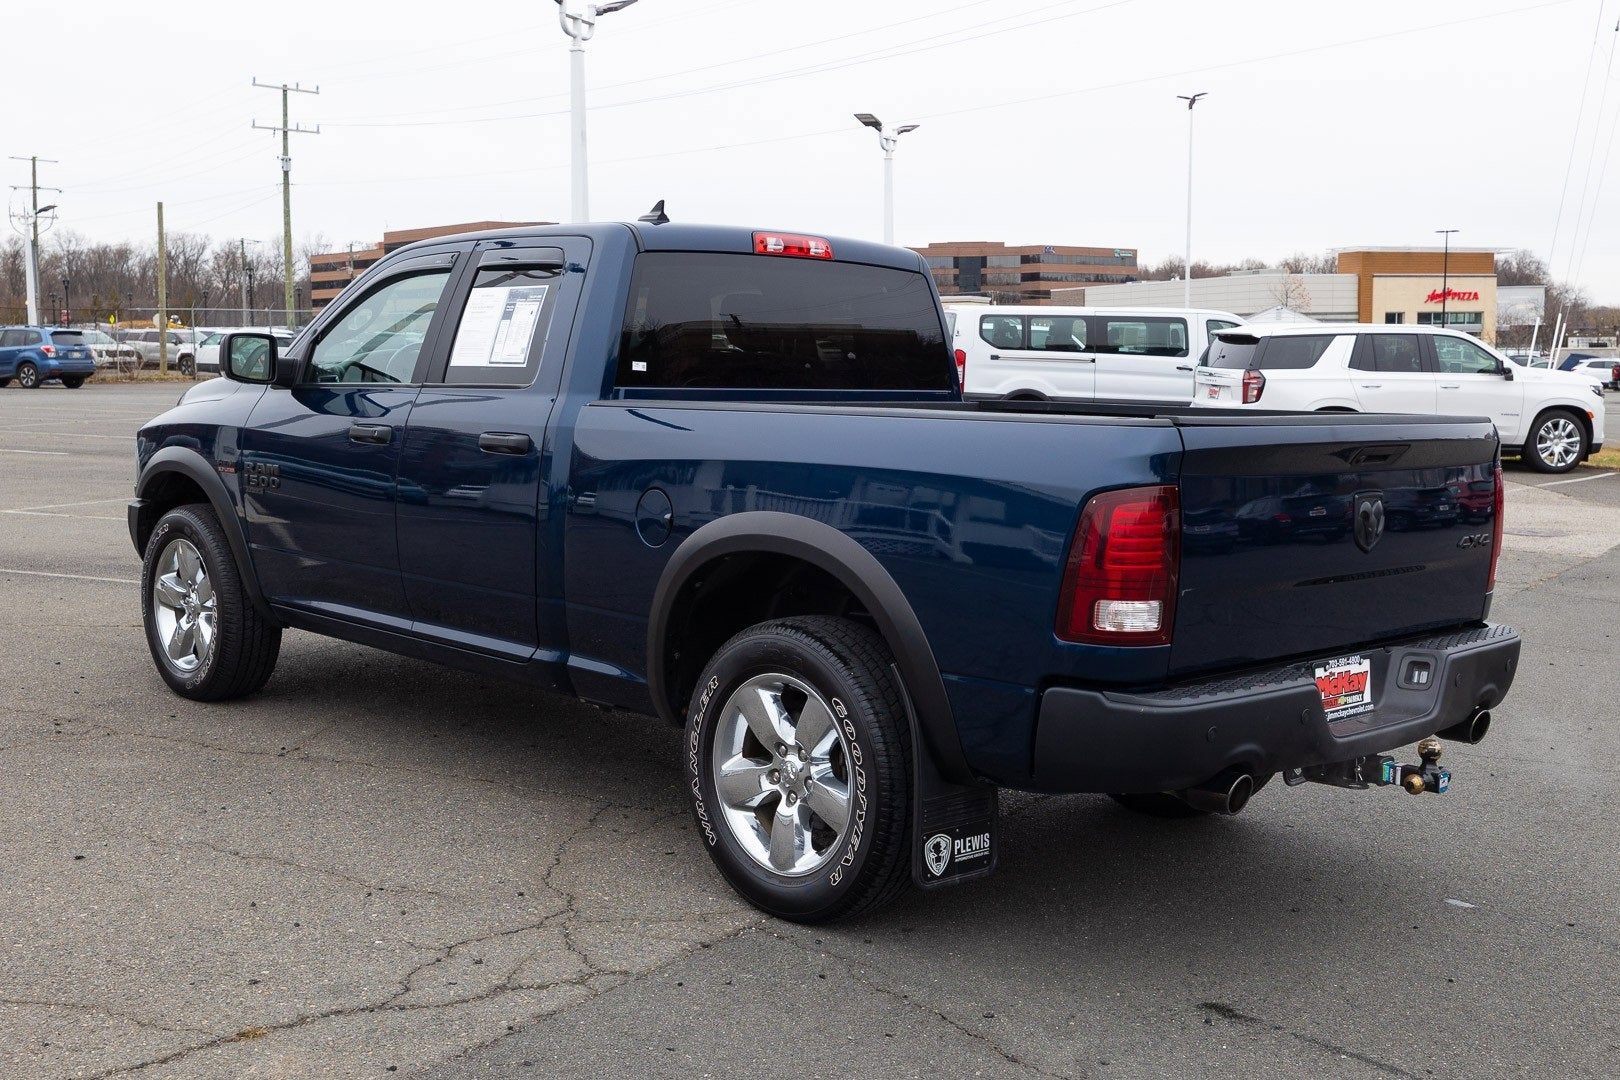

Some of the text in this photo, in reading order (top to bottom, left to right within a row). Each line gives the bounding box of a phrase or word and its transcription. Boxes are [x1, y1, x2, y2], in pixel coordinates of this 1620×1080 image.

[1452, 291, 1479, 301] PIZZA
[244, 461, 281, 476] RAM
[689, 676, 719, 846] WRANGLER
[831, 697, 867, 886] GOODYEAR
[954, 832, 990, 855] PLEWIS
